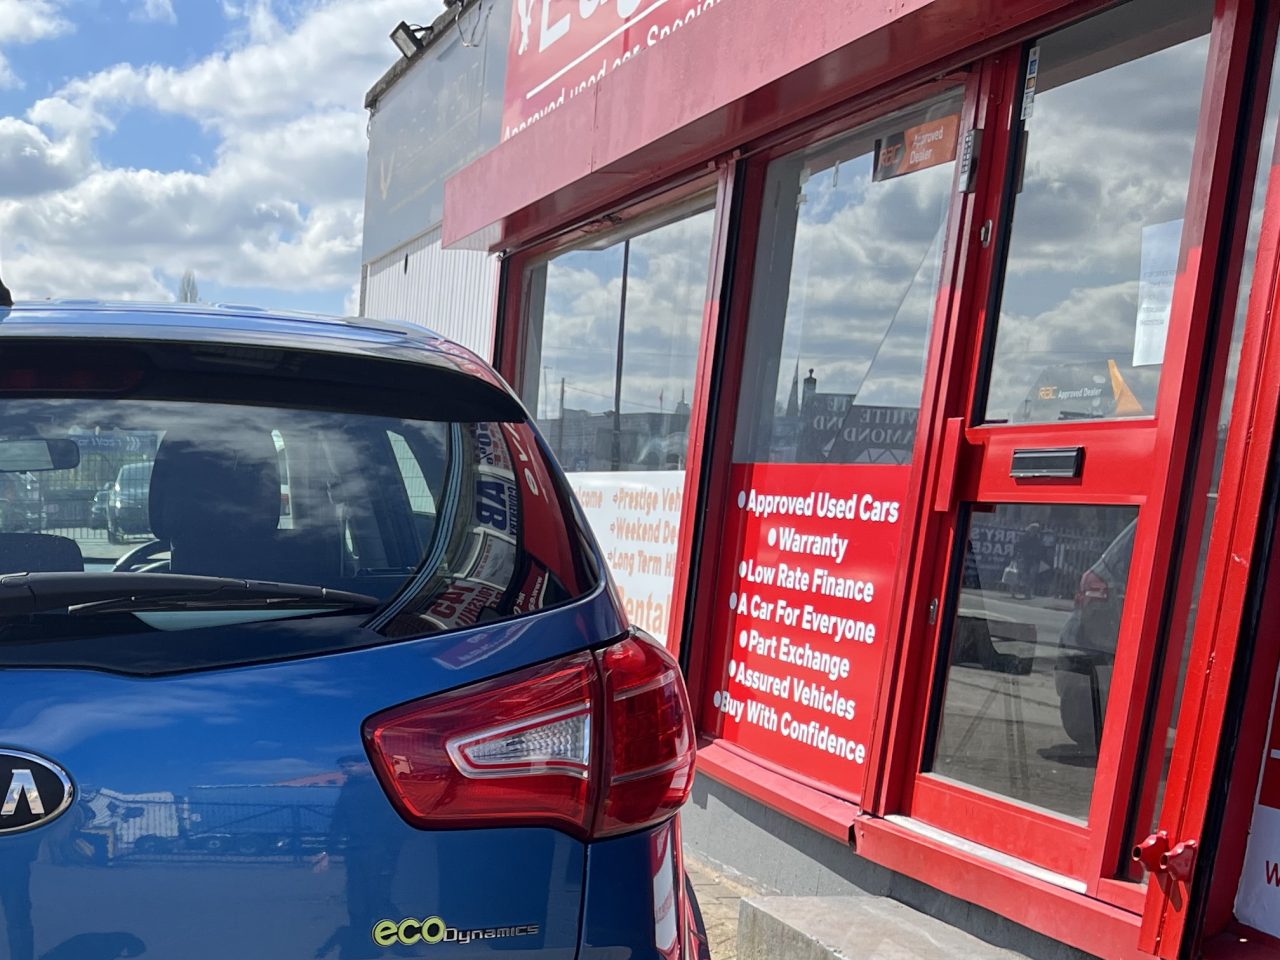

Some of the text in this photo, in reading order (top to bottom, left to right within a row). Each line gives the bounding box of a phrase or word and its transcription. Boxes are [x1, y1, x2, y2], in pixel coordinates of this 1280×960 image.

[618, 487, 659, 516] Prestige
[746, 489, 900, 524] Approved Used Cars
[616, 517, 661, 545] Weekend
[778, 527, 848, 564] Warranty
[612, 547, 634, 577] Long
[637, 549, 662, 575] Term
[747, 559, 874, 603] Low Rate Finance
[737, 592, 876, 645] A Car For Everyone
[748, 629, 850, 681] Part Exchange
[735, 662, 856, 721] Assured Vehicles
[720, 690, 866, 765] Buy With Confidence
